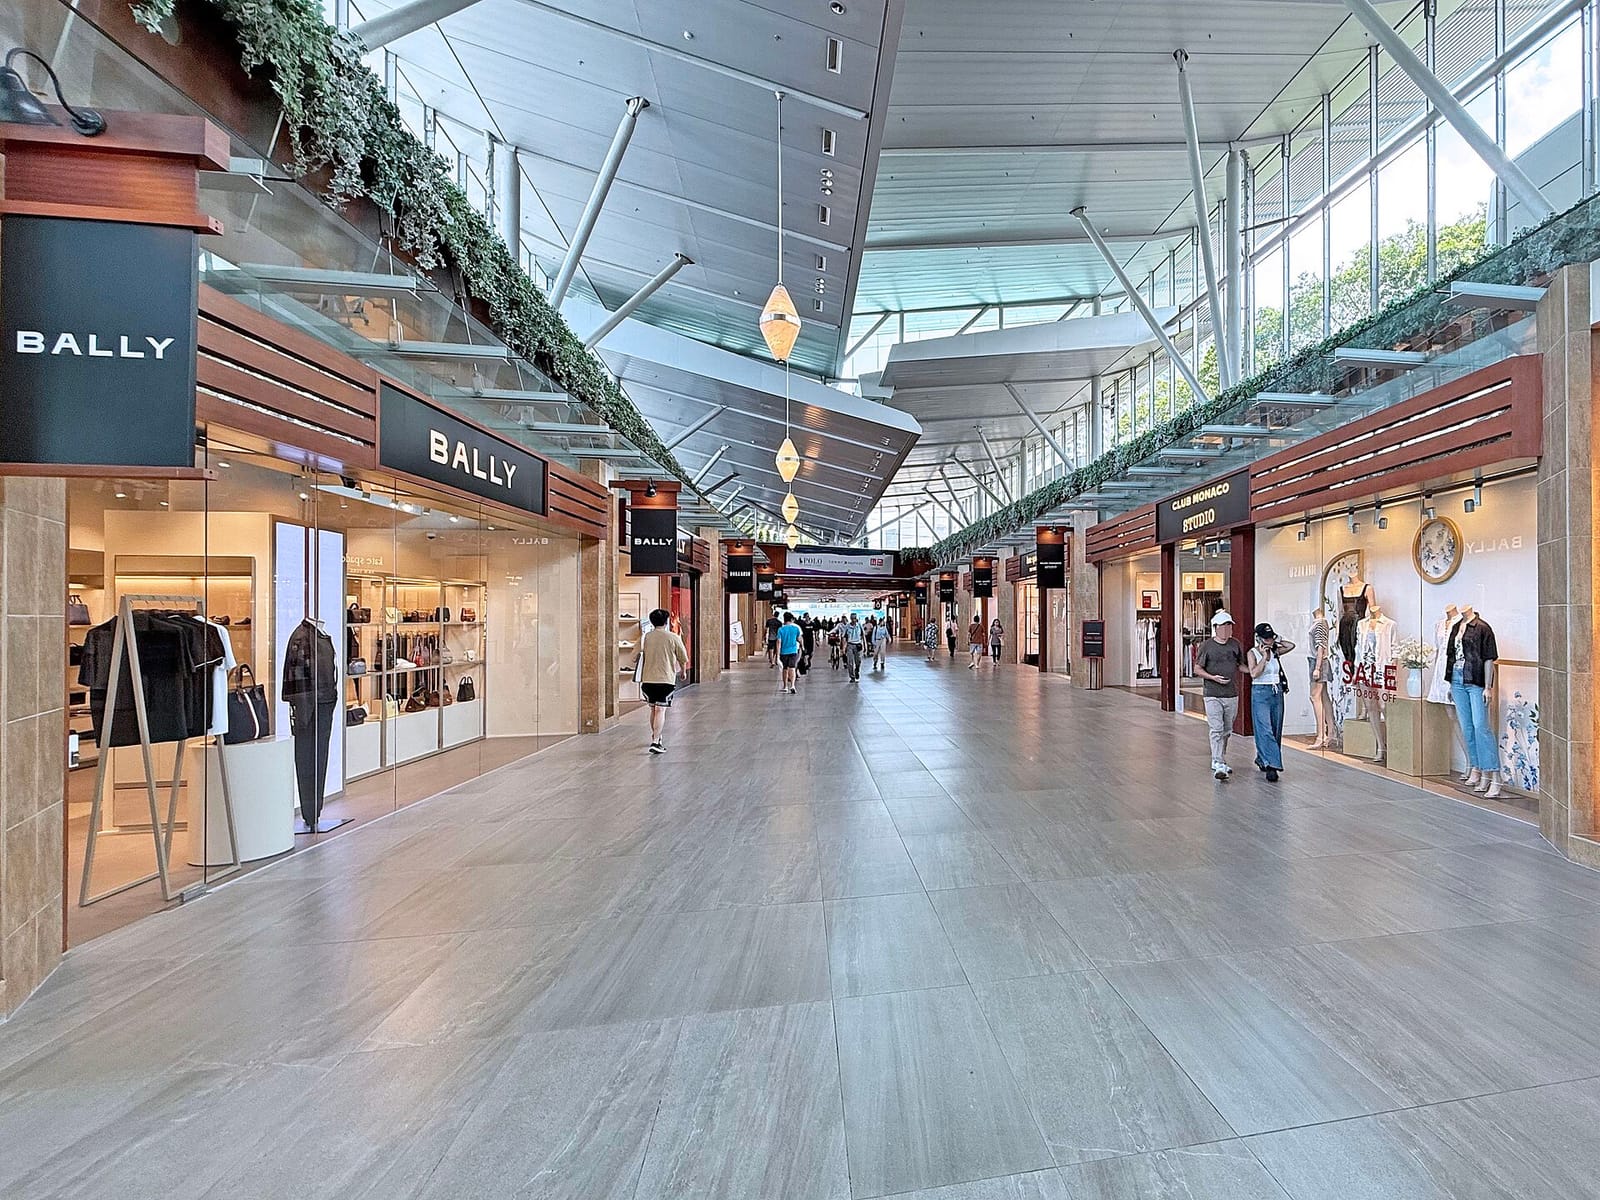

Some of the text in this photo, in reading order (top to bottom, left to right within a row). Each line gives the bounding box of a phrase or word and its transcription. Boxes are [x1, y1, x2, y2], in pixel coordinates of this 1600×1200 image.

[16, 329, 175, 360] BALLY
[429, 428, 517, 490] BALLY
[1171, 482, 1230, 511] CLUB MONACO
[1182, 508, 1215, 534] STUDIO
[634, 537, 673, 546] BALLY
[1342, 660, 1398, 692] SALE
[1352, 687, 1363, 698] TO
[1363, 689, 1381, 702] 80%
[1381, 692, 1397, 704] OFF
